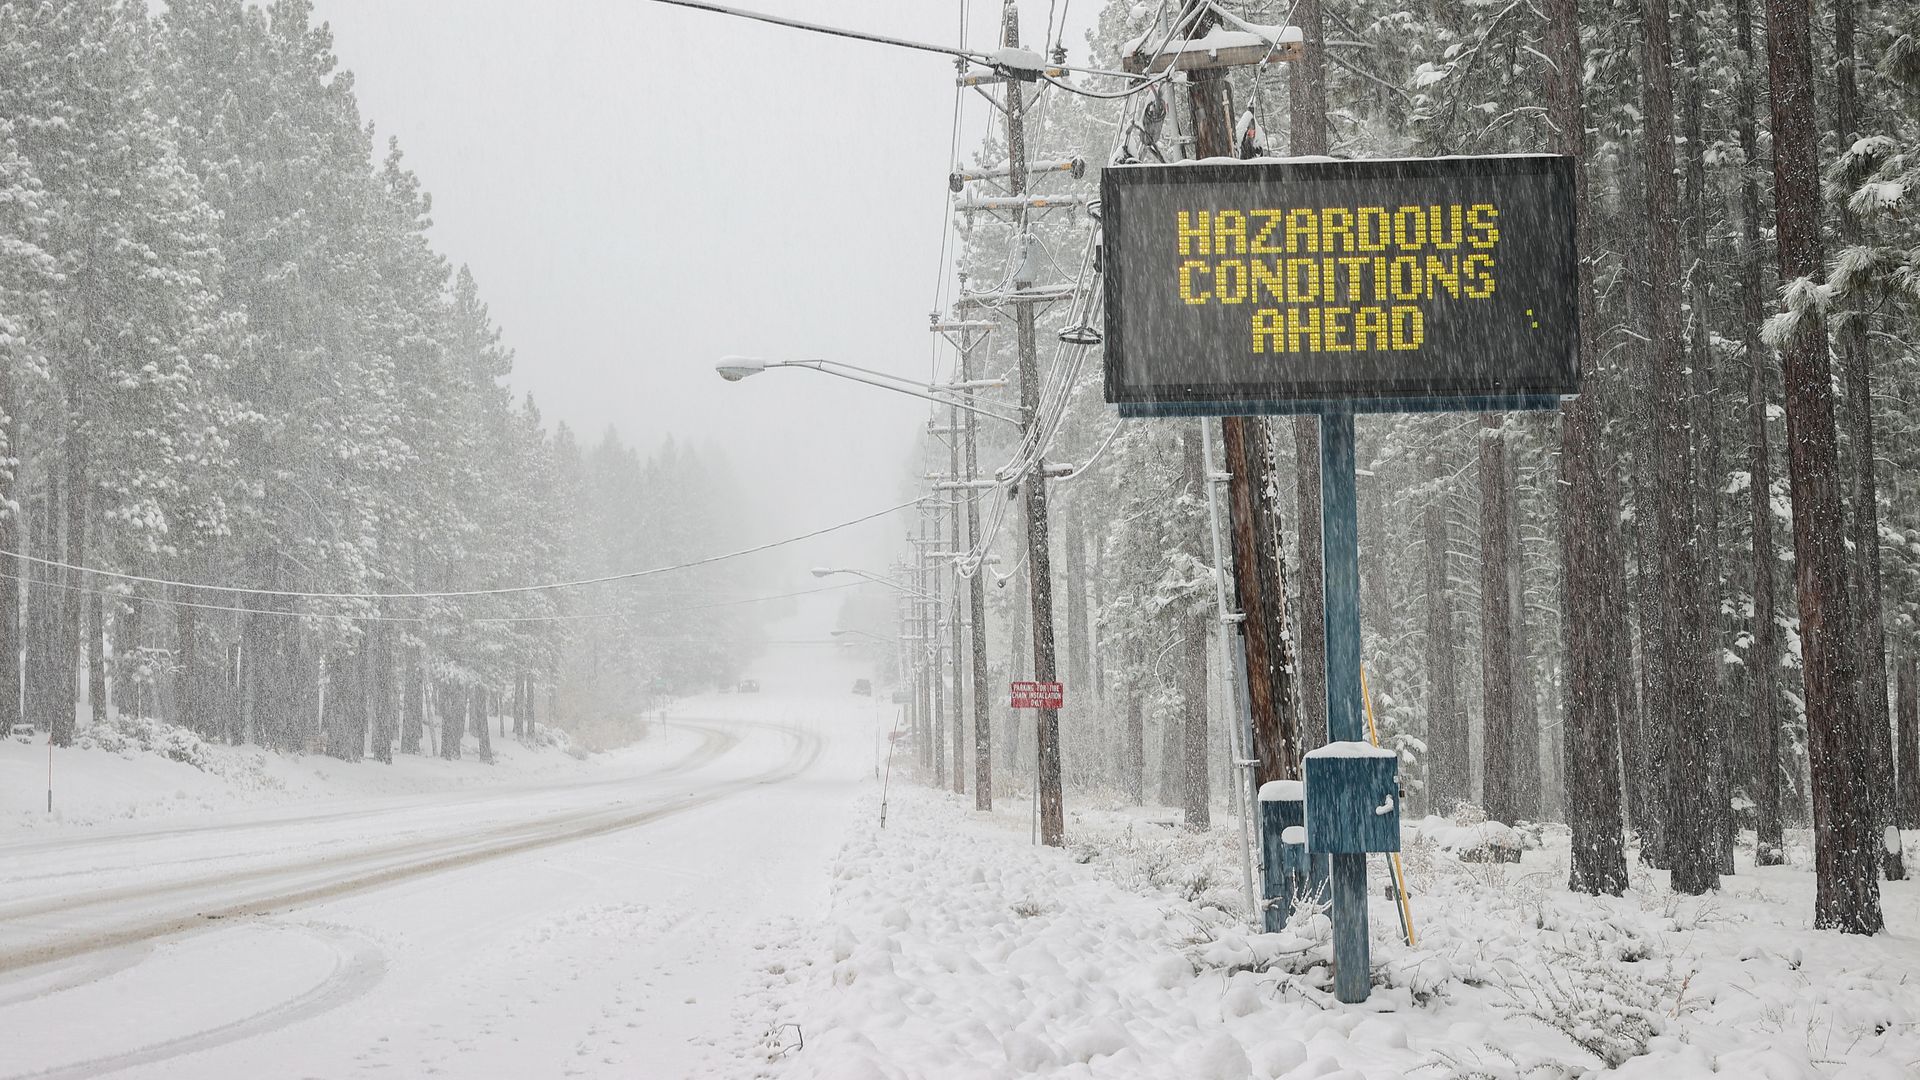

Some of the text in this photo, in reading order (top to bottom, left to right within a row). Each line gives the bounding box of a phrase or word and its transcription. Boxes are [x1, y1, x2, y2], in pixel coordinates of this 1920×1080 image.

[1178, 204, 1499, 255] HAZARDOUS
[1179, 254, 1496, 304] CONDITIONS
[1252, 305, 1424, 353] AHEAD
